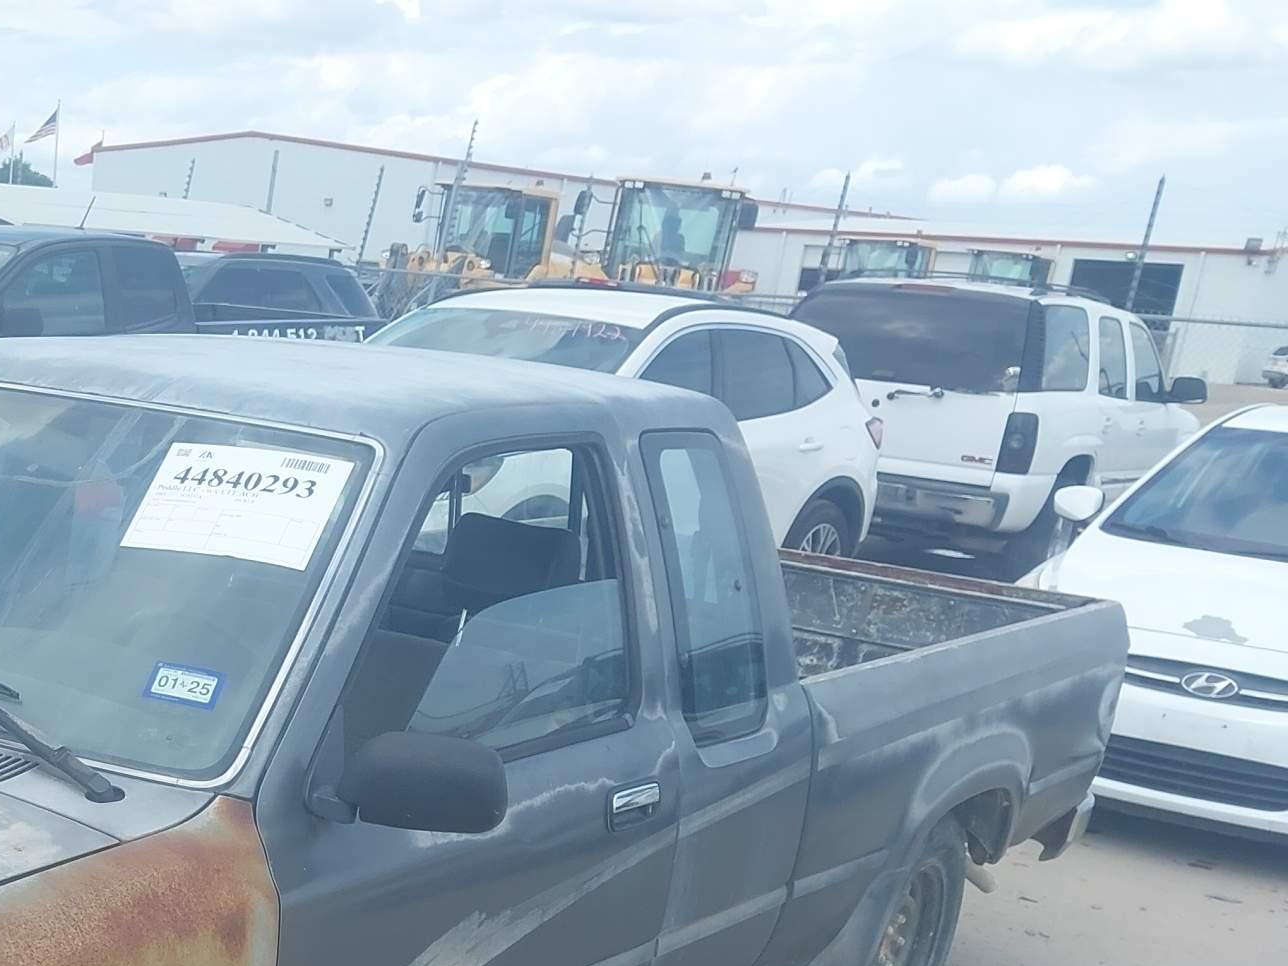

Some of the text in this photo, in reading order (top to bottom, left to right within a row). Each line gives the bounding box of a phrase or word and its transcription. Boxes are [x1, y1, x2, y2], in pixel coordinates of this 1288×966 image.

[961, 455, 993, 465] GMC
[174, 466, 317, 498] 44840293
[158, 675, 213, 696] 01 25
